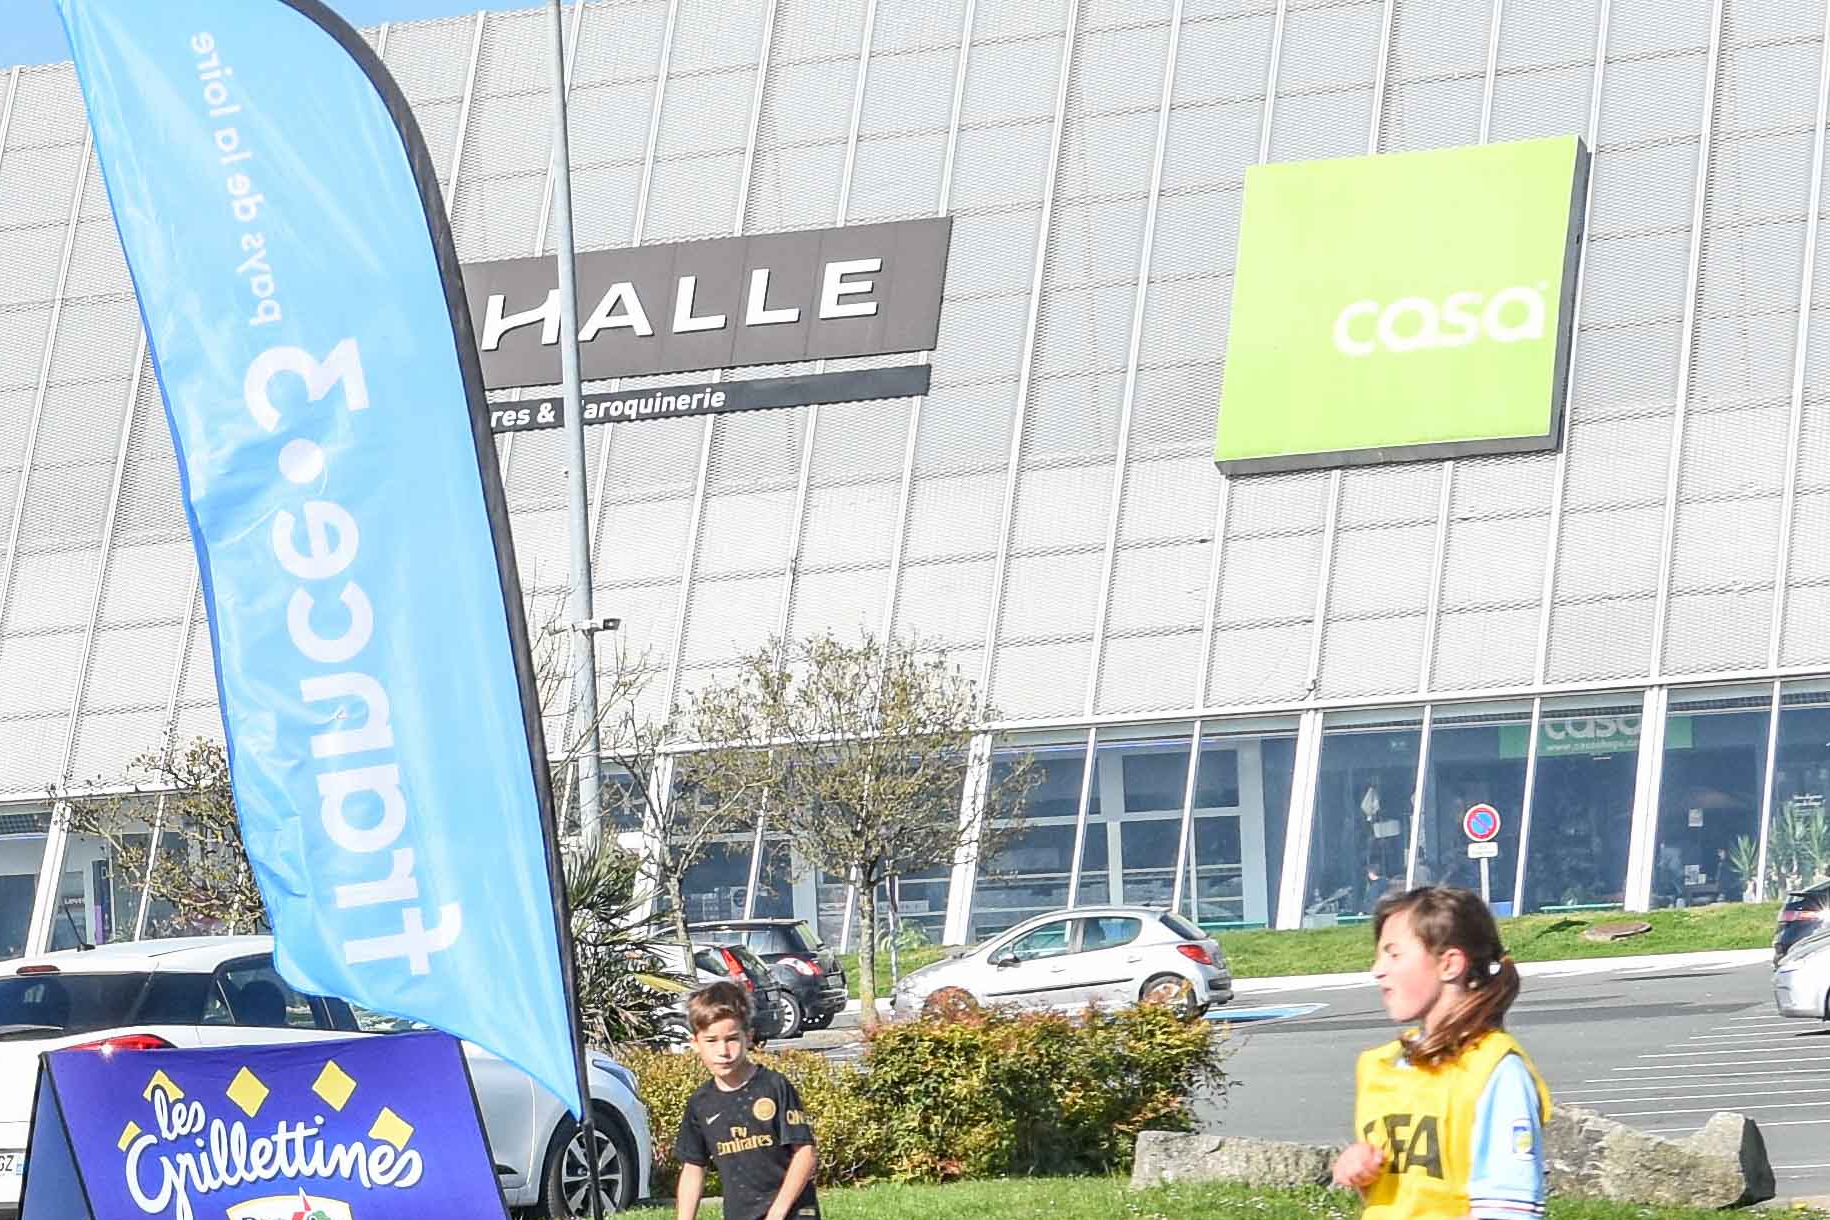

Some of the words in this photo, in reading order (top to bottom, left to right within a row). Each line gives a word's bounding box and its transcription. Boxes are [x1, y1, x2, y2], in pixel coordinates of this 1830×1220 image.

[481, 258, 883, 351] HALLE
[1333, 287, 1546, 358] casa
[536, 402, 555, 423] &
[582, 388, 726, 419] aroquinerie
[154, 1088, 206, 1141] les
